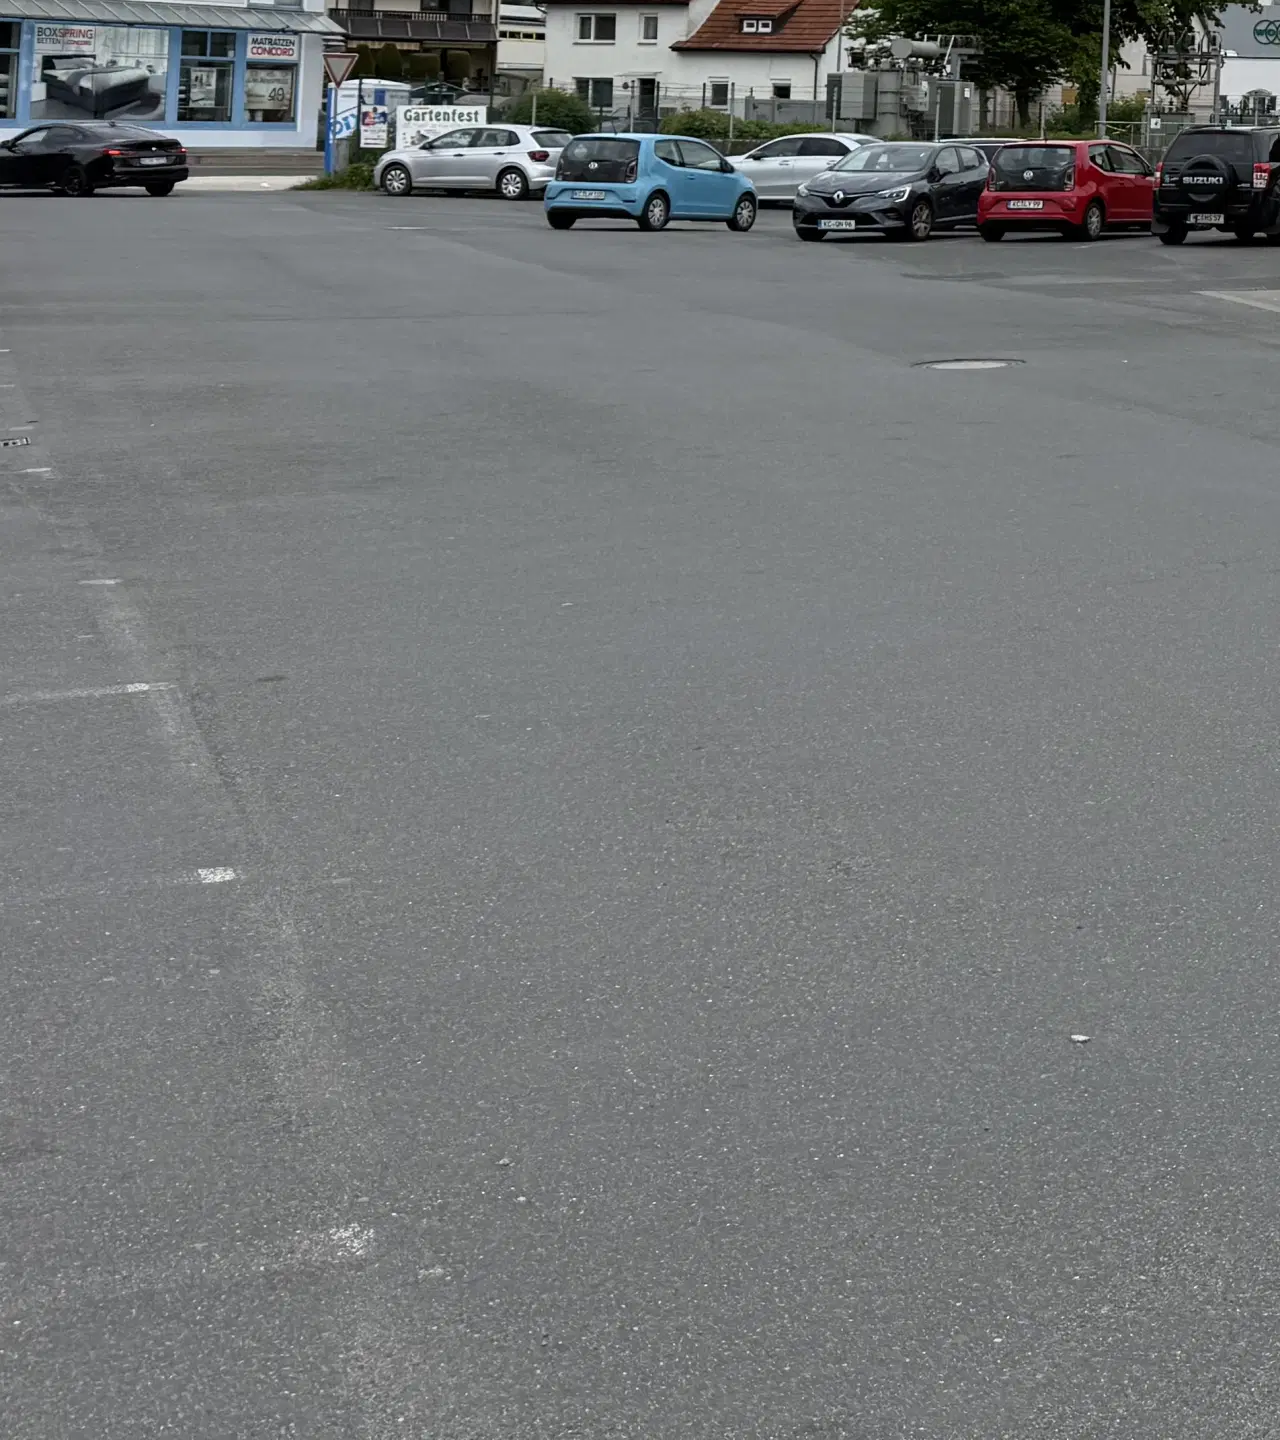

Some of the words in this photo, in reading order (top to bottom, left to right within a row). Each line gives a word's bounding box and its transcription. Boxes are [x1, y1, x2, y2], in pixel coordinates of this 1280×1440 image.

[36, 26, 94, 40] BOXSPRING
[251, 37, 296, 47] MATRATZEN
[250, 46, 295, 57] CONCORD
[403, 108, 479, 122] Gartenfest
[1182, 176, 1223, 184] SUZUKI
